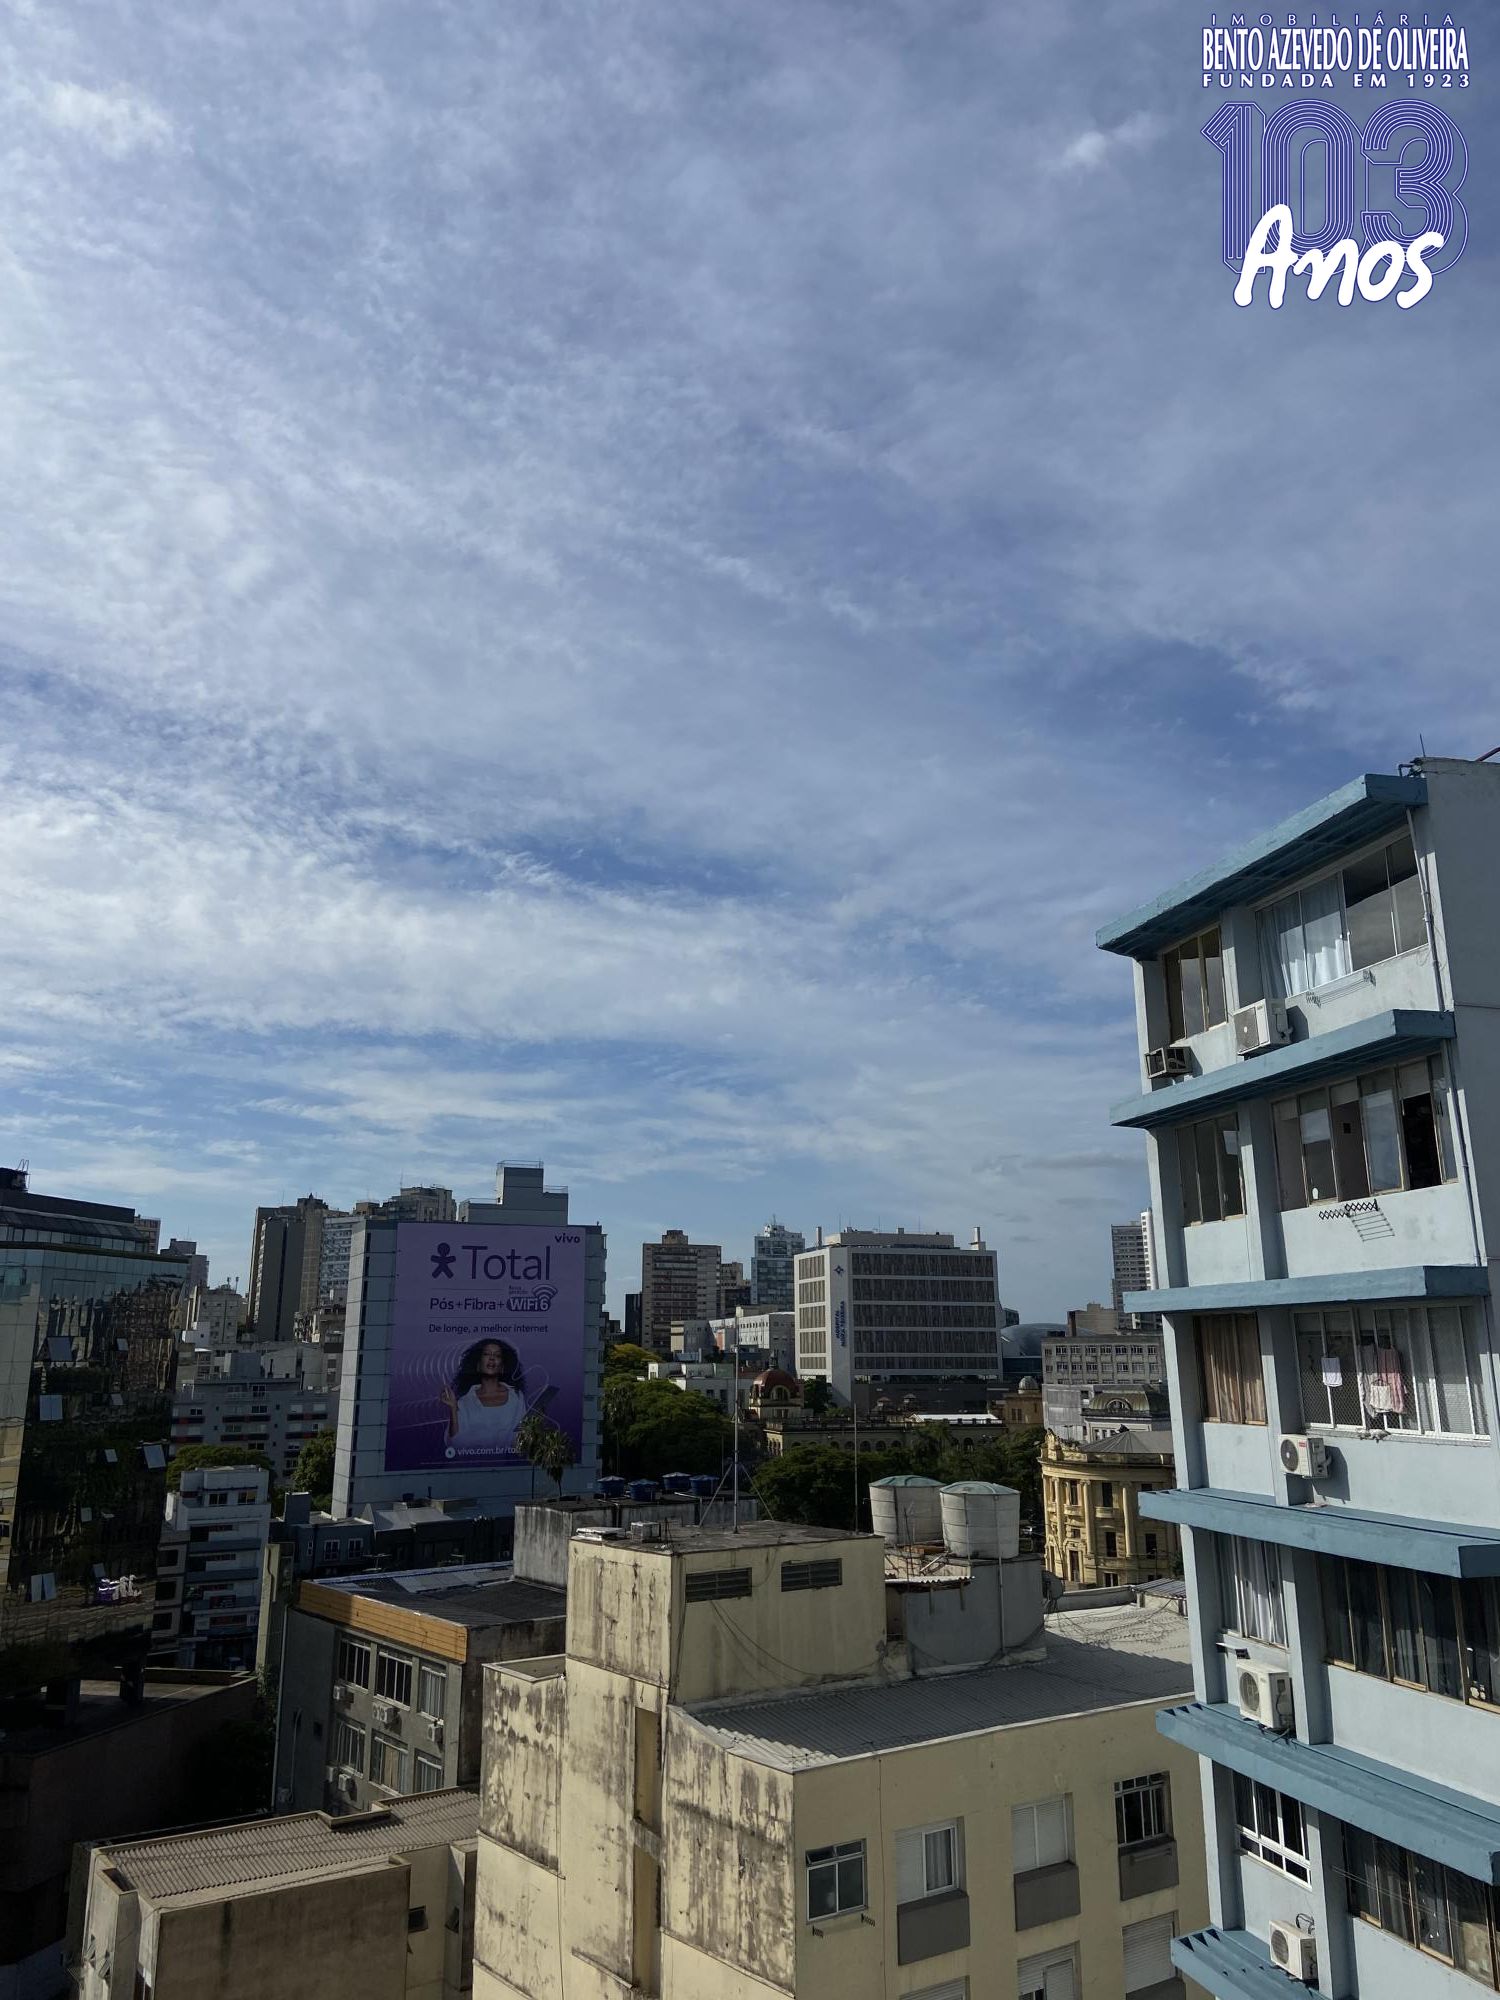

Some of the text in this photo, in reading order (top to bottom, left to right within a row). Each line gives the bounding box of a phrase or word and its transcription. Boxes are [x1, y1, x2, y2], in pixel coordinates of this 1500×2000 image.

[554, 1233, 581, 1244] vivo
[461, 1245, 551, 1281] Total
[480, 1324, 512, 1333] melhor
[513, 1324, 548, 1333] internet
